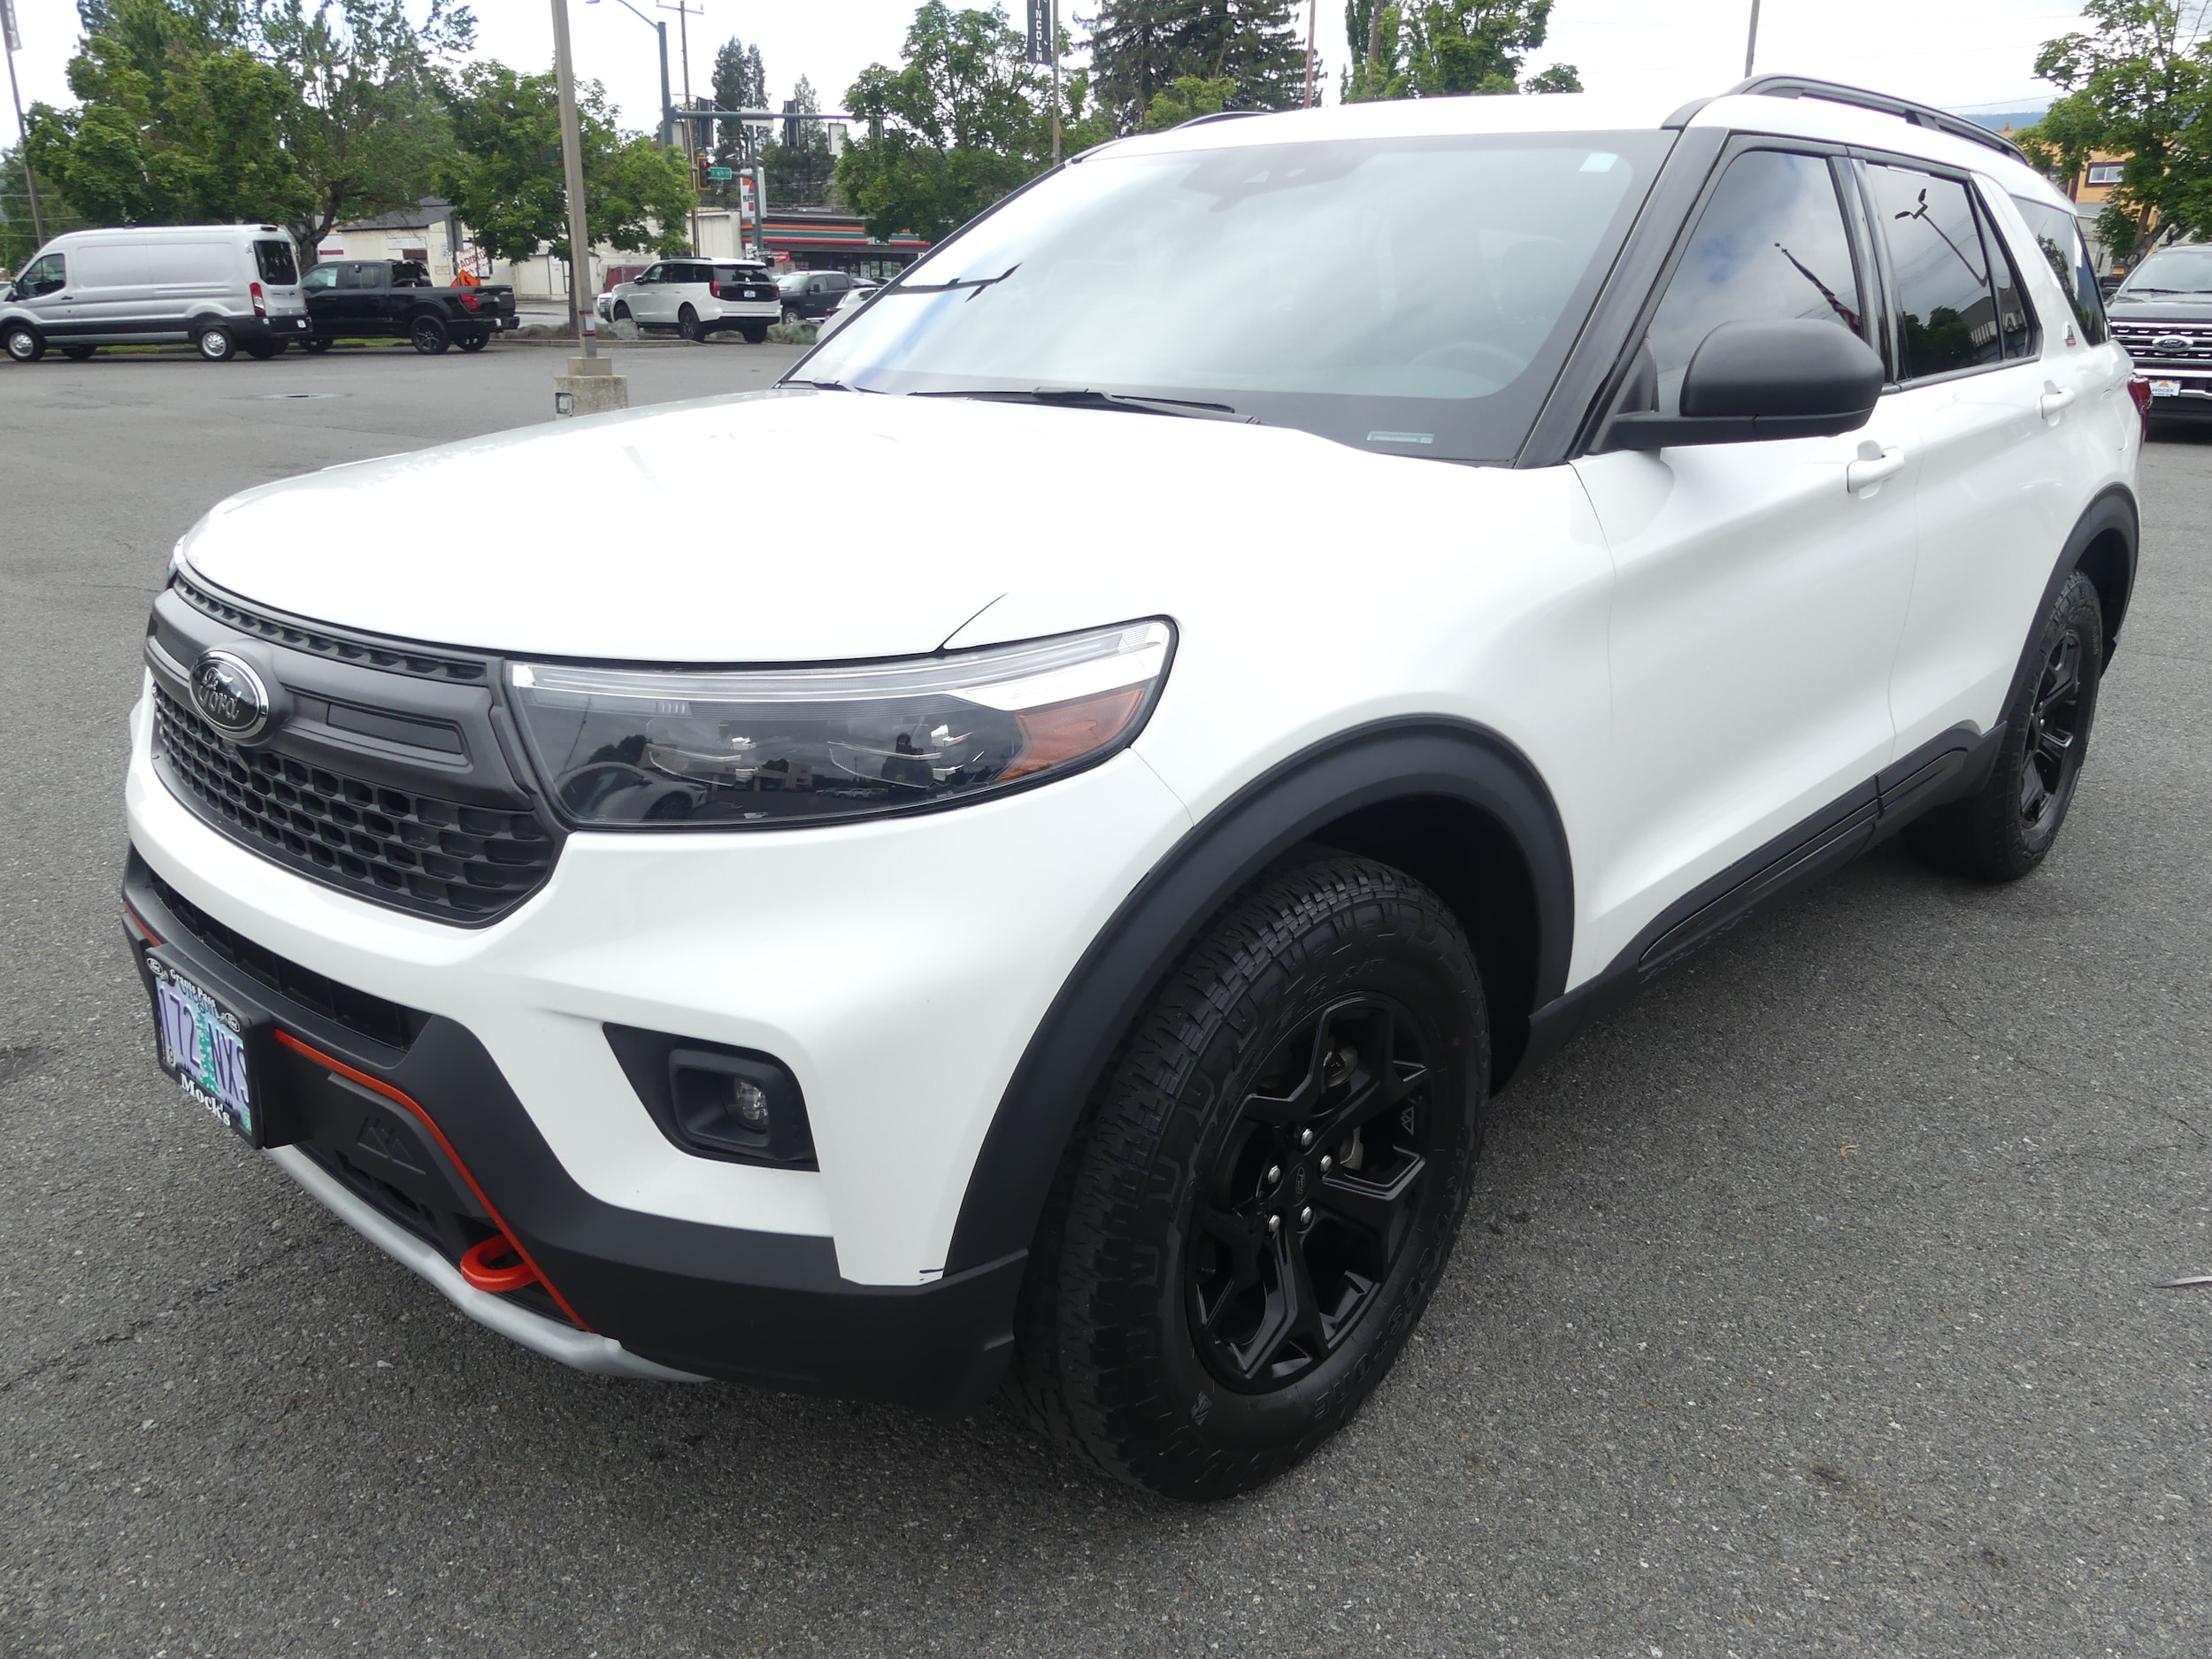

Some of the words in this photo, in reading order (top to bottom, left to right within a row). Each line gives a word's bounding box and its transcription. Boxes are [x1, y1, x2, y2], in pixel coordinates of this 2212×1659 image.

[170, 968, 196, 994] Grants
[197, 987, 217, 1008] Pass
[160, 987, 201, 1070] 172
[180, 1073, 231, 1126] Mock's
